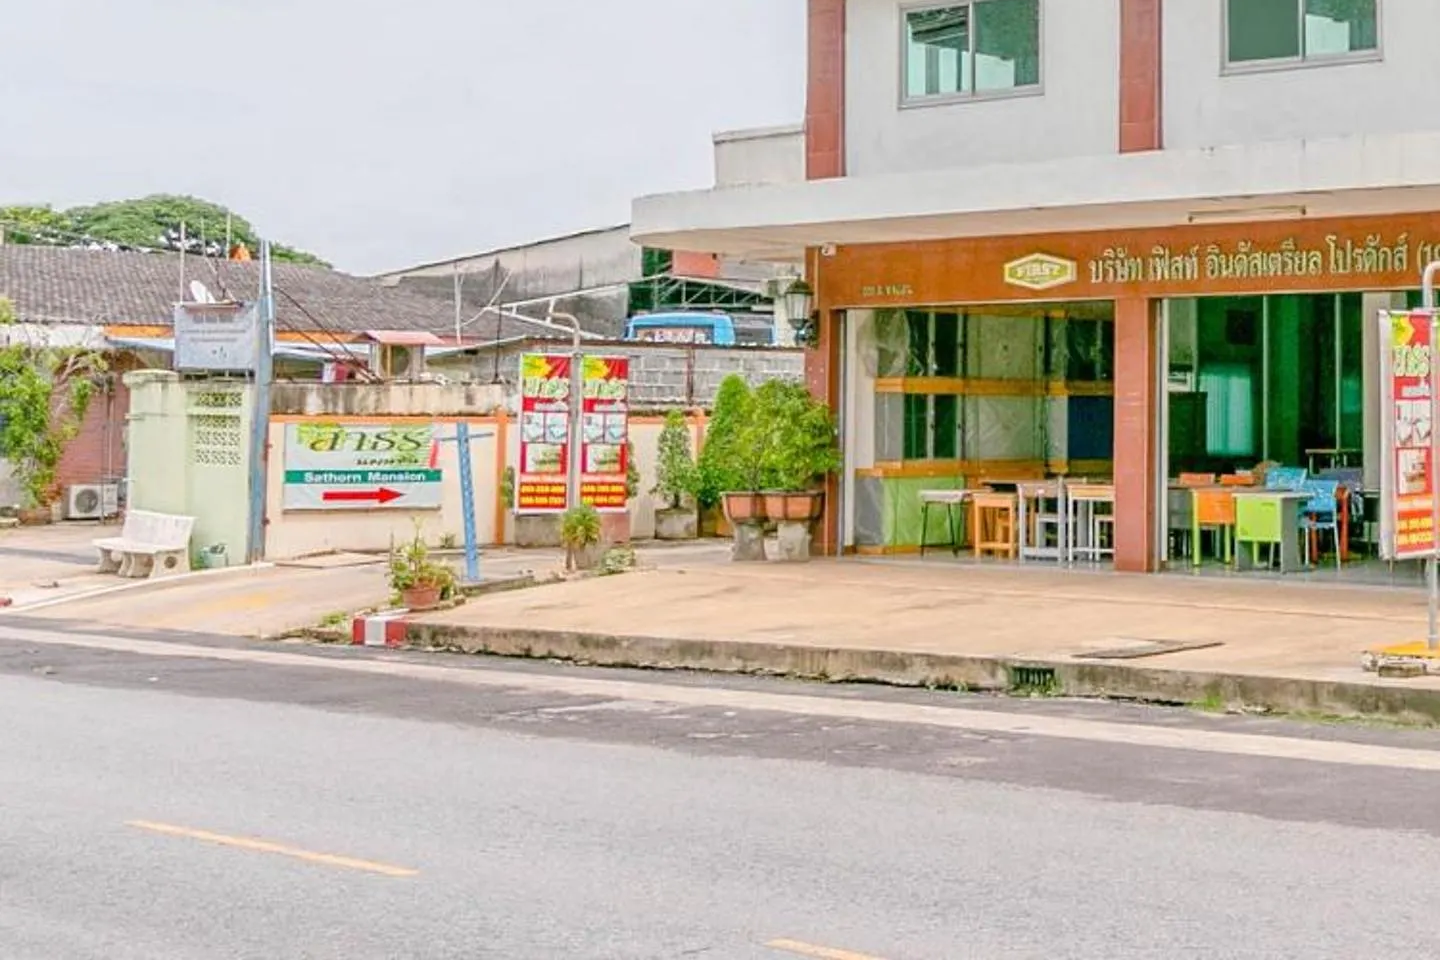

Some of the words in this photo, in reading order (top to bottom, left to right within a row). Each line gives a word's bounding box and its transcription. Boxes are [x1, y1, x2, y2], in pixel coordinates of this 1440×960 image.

[1087, 246, 1143, 284] บริษัท
[1149, 243, 1199, 282] เฟิสท์
[304, 471, 362, 484] Sathorn
[368, 471, 426, 483] Mansion
